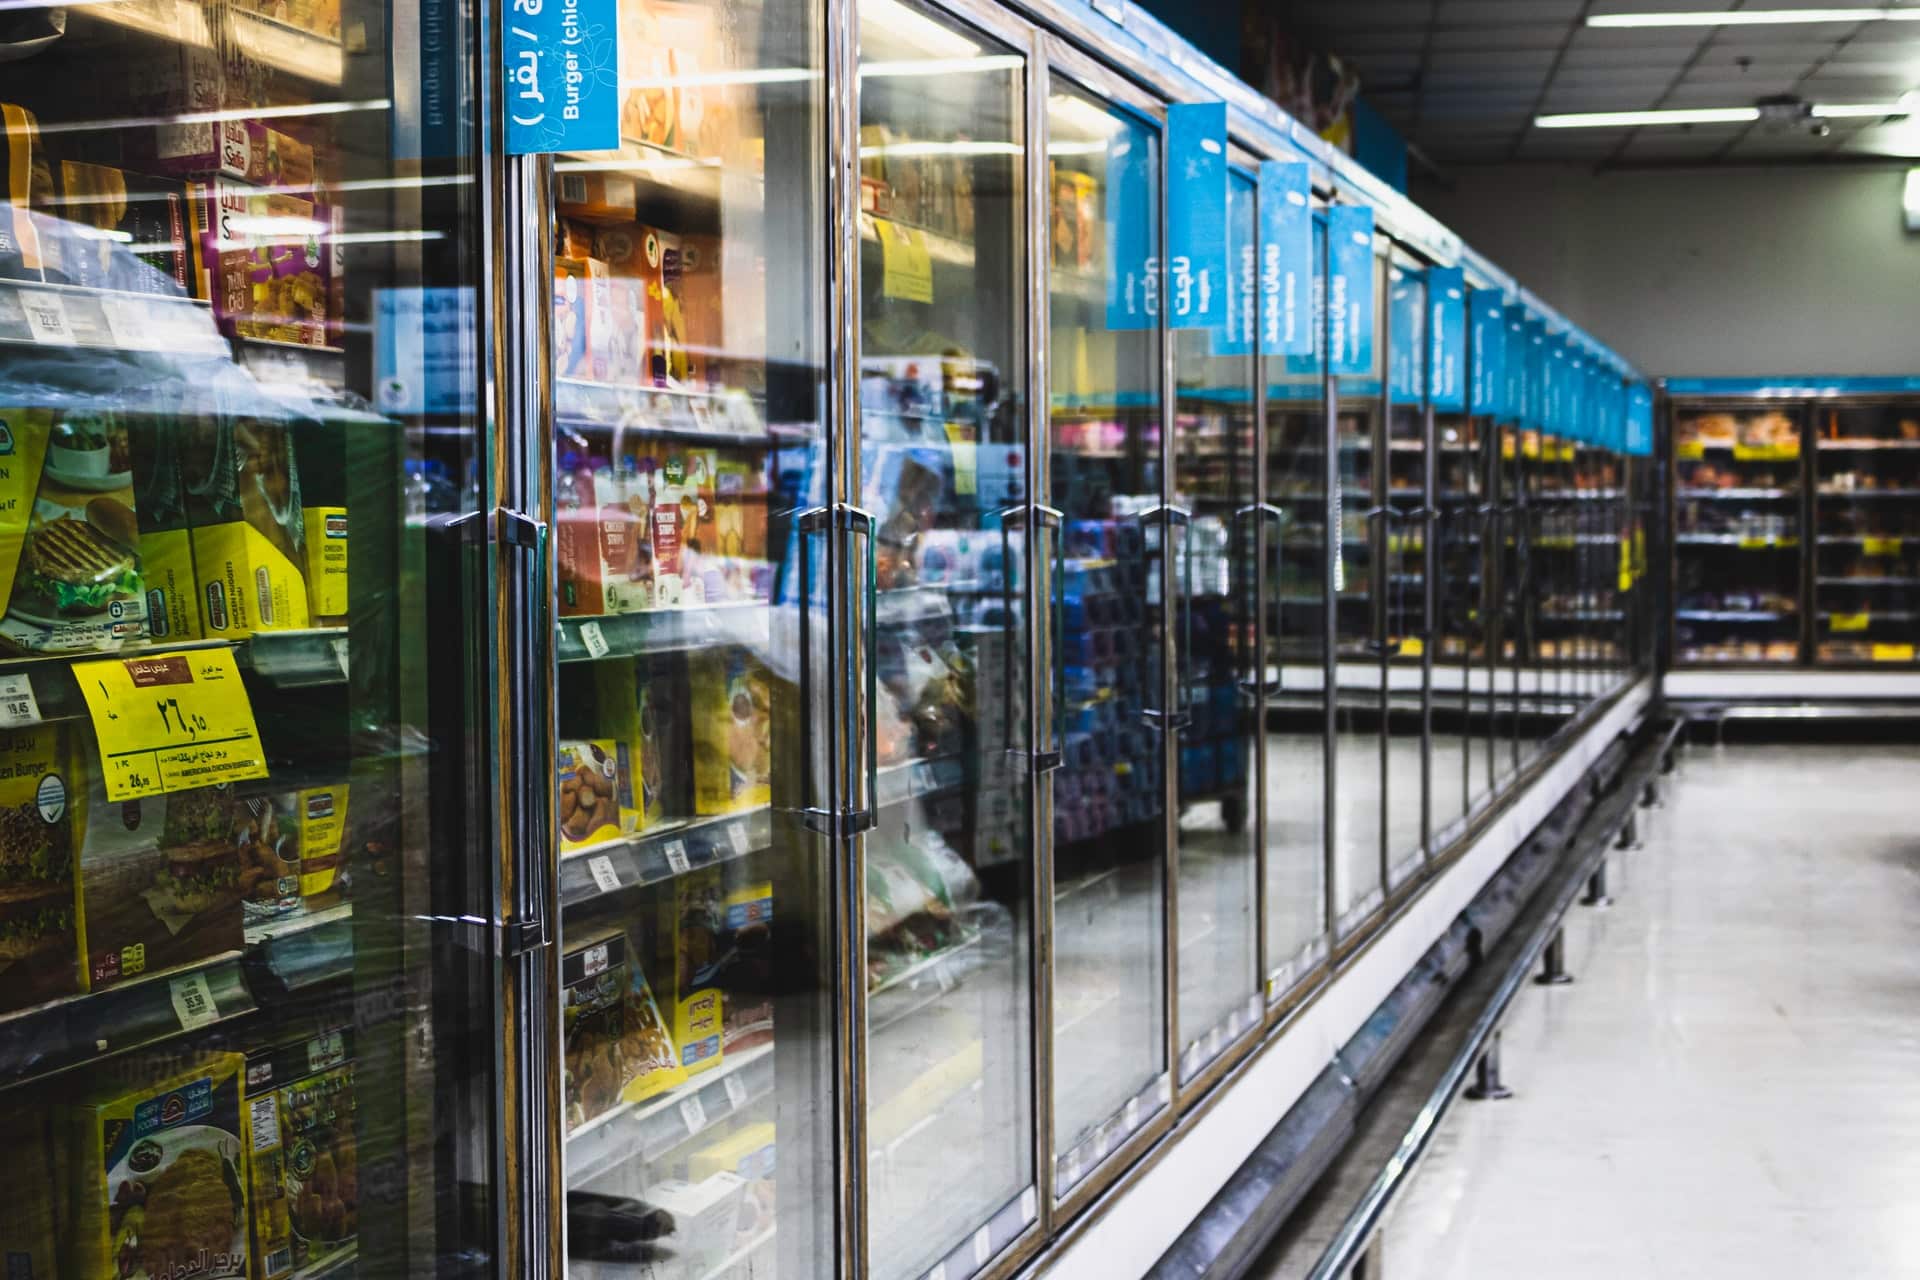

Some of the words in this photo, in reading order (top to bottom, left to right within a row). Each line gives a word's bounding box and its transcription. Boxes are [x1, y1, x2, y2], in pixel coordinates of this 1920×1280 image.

[509, 51, 545, 103] بقر
[563, 50, 583, 120] Burger
[225, 561, 237, 597] NUGGETS
[230, 597, 241, 630] CHICKEN
[15, 762, 48, 778] Burger
[181, 767, 211, 777] AMERICANA
